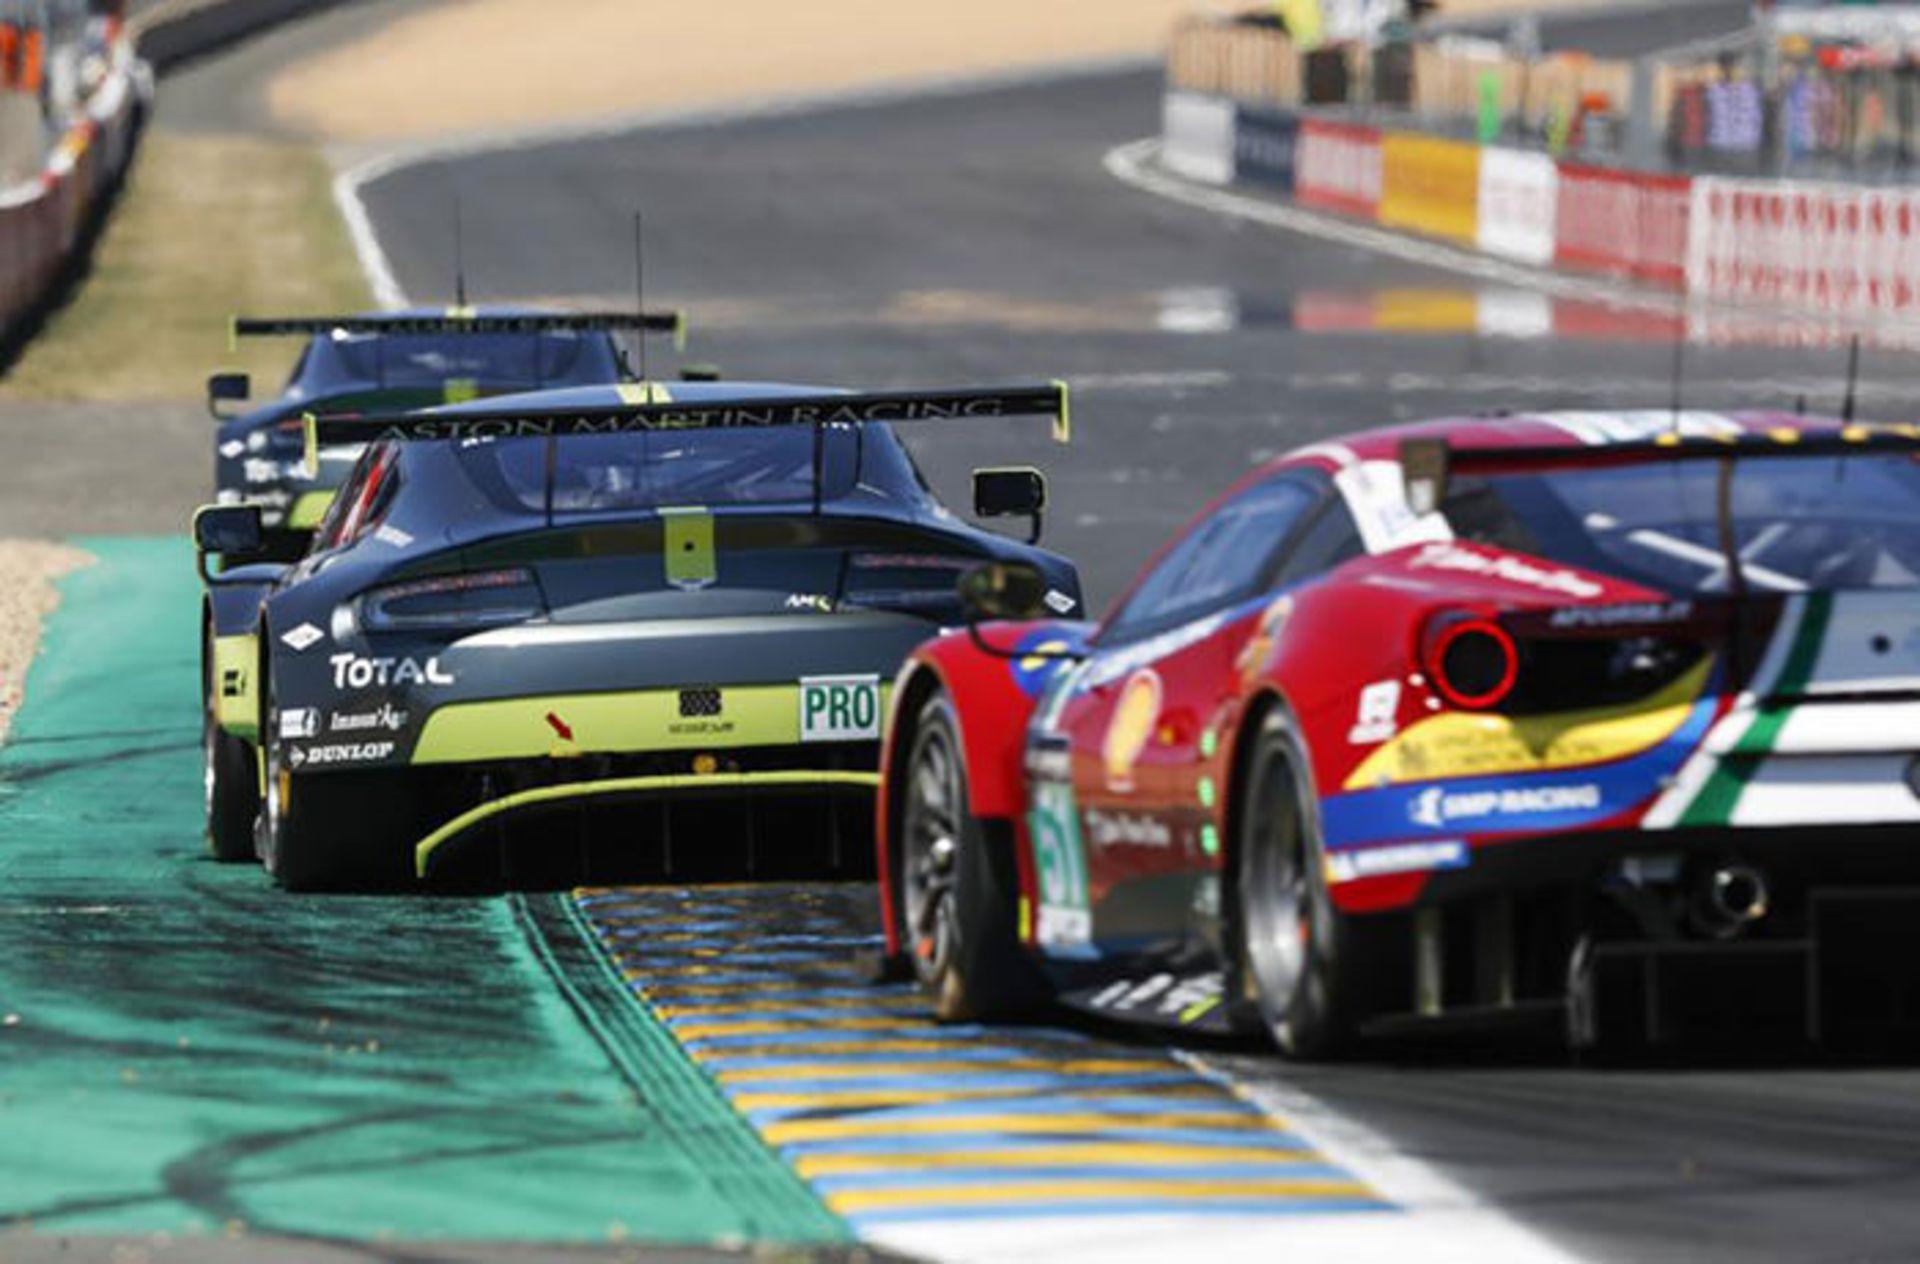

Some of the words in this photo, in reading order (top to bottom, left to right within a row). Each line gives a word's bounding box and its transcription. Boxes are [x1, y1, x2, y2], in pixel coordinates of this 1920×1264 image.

[380, 417, 553, 441] ASTON
[573, 406, 773, 432] MARTIN
[793, 399, 1003, 423] RACING
[329, 653, 454, 688] TOTAL
[805, 684, 875, 730] PRO
[307, 742, 395, 764] DUNLOP
[1500, 785, 1600, 813] RACING
